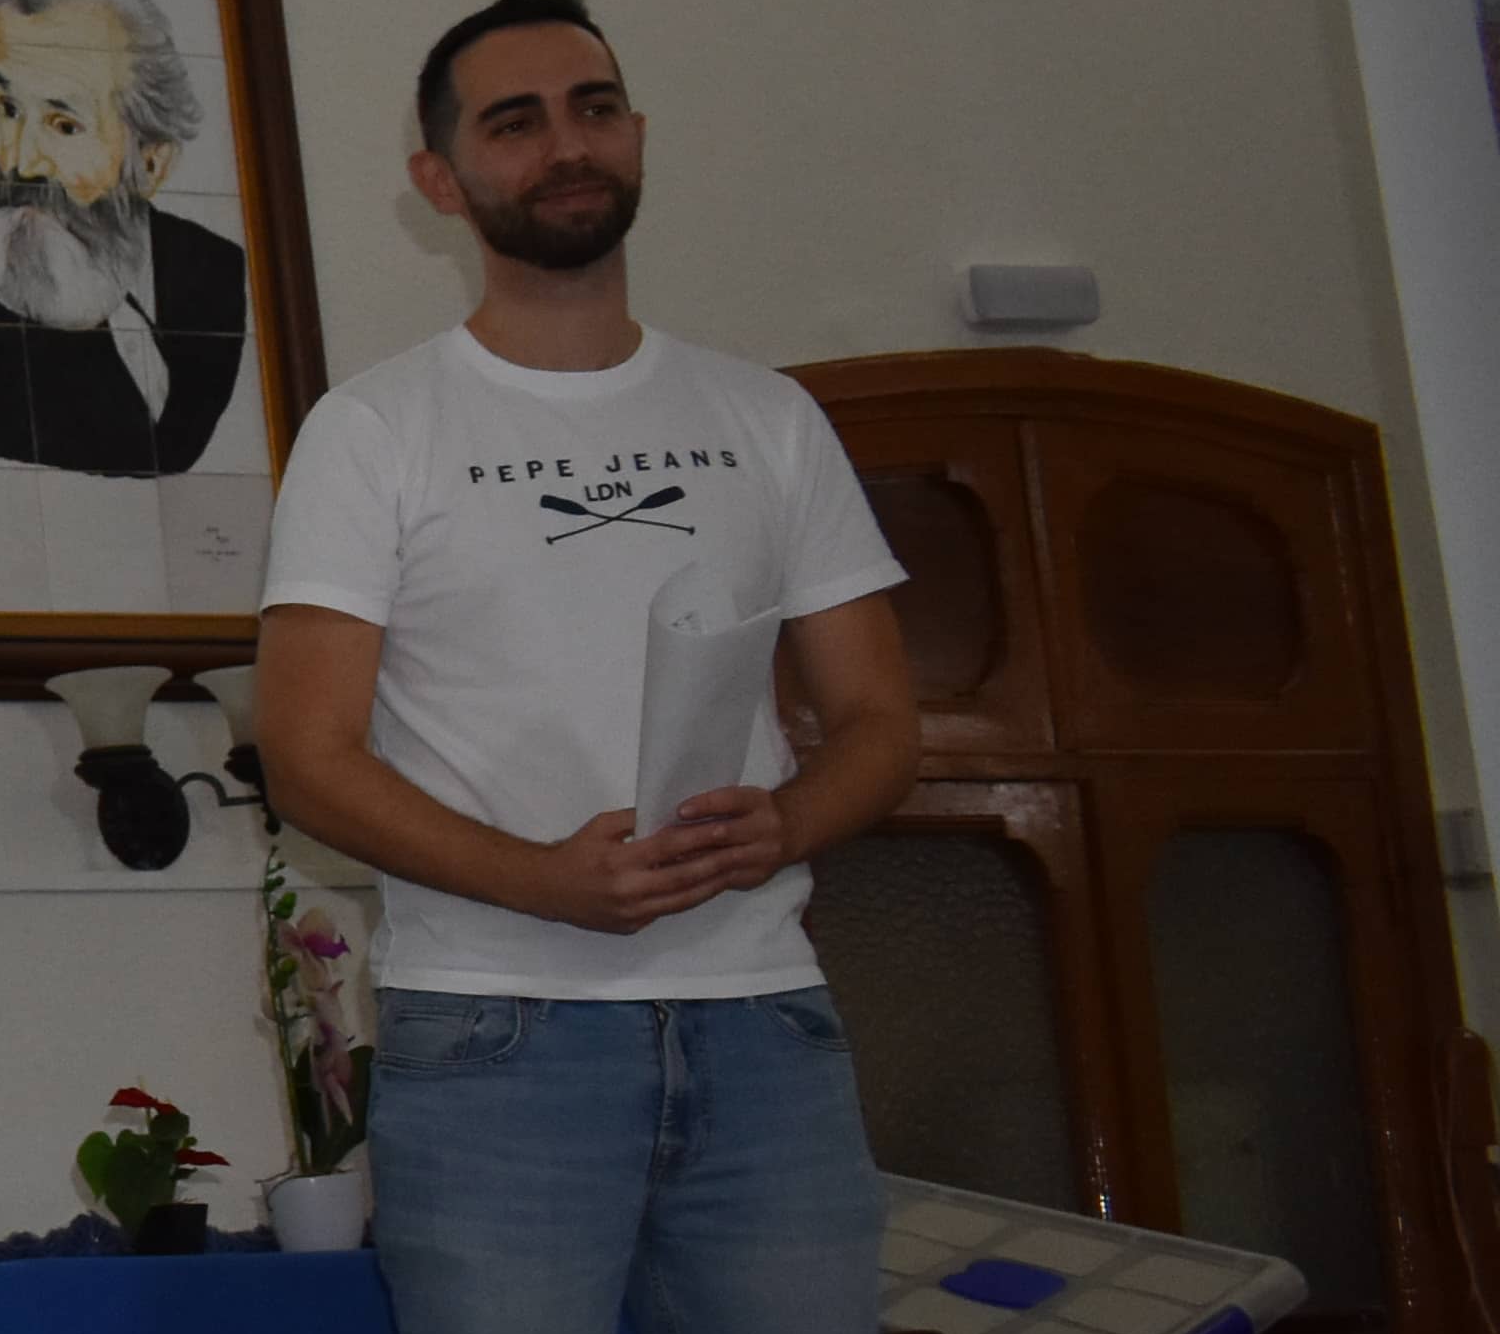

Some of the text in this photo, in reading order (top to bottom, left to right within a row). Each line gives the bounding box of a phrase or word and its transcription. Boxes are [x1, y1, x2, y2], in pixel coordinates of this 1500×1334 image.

[469, 450, 738, 484] PEPE JEANS
[585, 481, 633, 503] LDN
